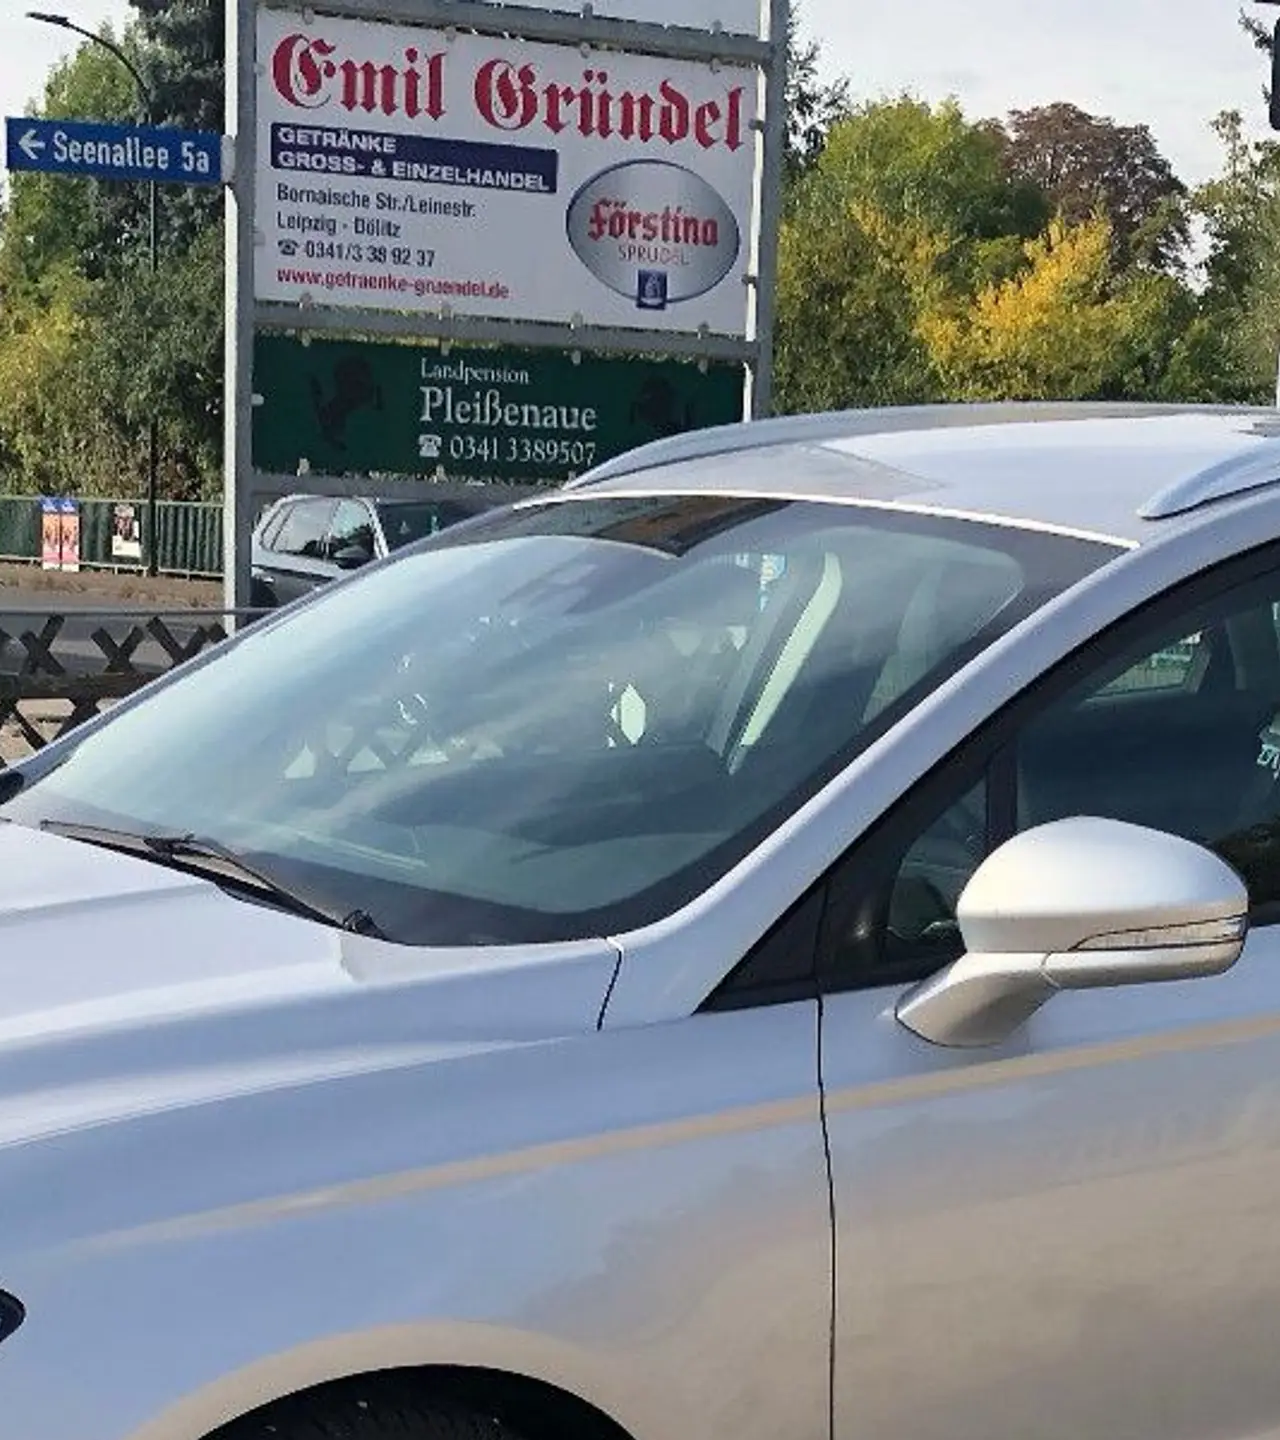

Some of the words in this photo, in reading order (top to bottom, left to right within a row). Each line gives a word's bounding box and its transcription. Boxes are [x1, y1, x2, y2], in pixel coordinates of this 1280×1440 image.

[273, 33, 447, 120] Emil
[474, 58, 745, 151] Gründel
[53, 130, 169, 169] Seenallee
[181, 141, 210, 173] 5a
[277, 127, 397, 153] GETRÄNKE
[277, 151, 365, 173] GROSS-
[371, 159, 387, 177] &
[392, 161, 550, 192] EINZELHANDEL
[277, 183, 371, 209] Bornaische
[277, 211, 337, 236] Leipzig
[355, 216, 401, 238] Dölitz
[588, 198, 719, 247] Förstina
[391, 247, 411, 265] 92
[417, 249, 436, 267] 37
[619, 245, 690, 266] SPRUDEL
[277, 269, 510, 298] www.getraenke-gruendel.de
[421, 358, 529, 385] Landpension
[420, 386, 597, 430] Pleißenaue
[450, 435, 498, 462] 0341
[506, 436, 596, 465] 3389507
